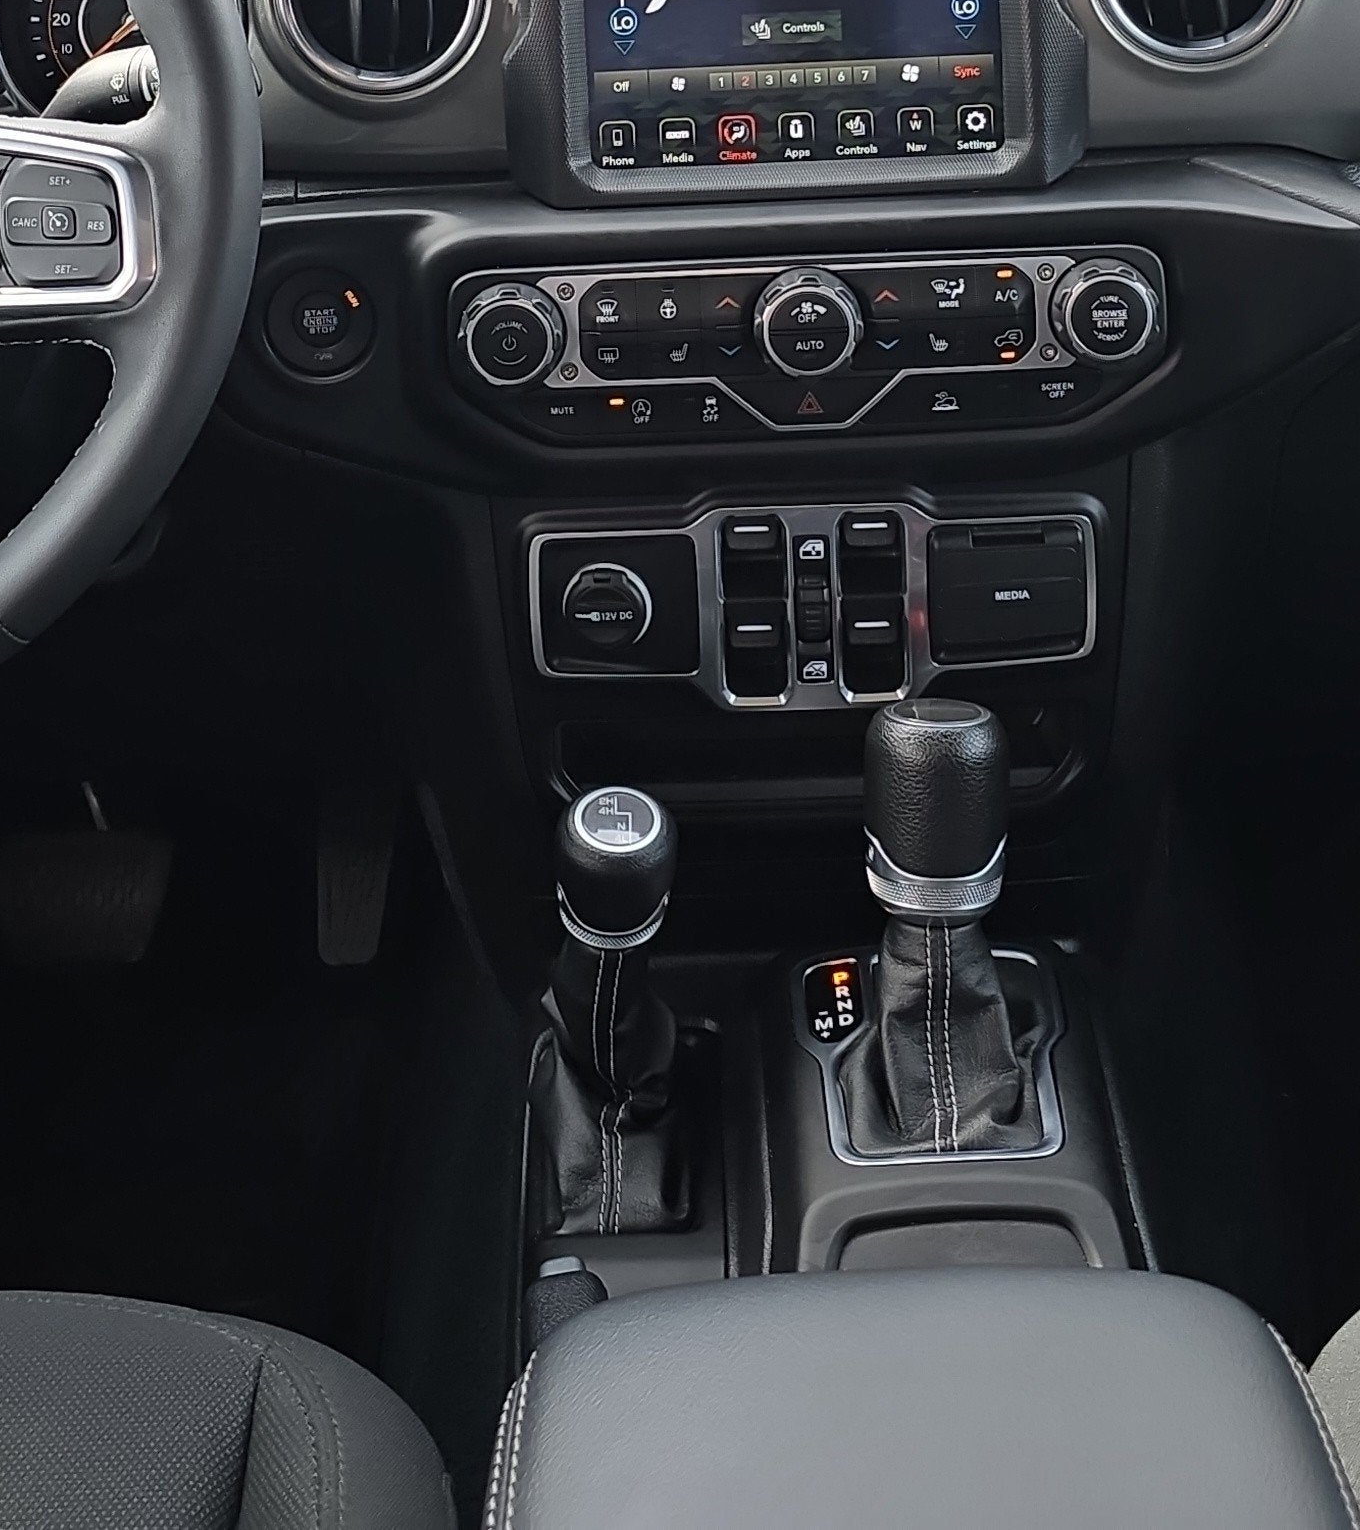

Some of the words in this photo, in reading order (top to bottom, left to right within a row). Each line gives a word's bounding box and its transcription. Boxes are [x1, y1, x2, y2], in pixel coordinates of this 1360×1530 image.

[954, 0, 976, 14] LO
[52, 13, 71, 26] 20
[613, 15, 635, 30] LO
[783, 21, 825, 35] Controls
[61, 43, 73, 54] 10
[954, 65, 980, 79] Sync
[718, 76, 724, 87] 1
[741, 76, 750, 87] 2
[765, 75, 774, 85] 3
[789, 73, 798, 84] 4
[814, 72, 821, 83] 5
[837, 71, 845, 82] 6
[861, 70, 869, 81] 7
[613, 81, 630, 92] Off
[112, 94, 130, 105] PULL
[909, 120, 922, 131] W
[836, 144, 878, 155] Controls
[906, 142, 927, 152] Nav
[957, 139, 997, 151] Settings
[662, 153, 694, 163] Media
[719, 150, 757, 161] Climate
[784, 148, 810, 159] Apps
[602, 155, 635, 167] Phone
[12, 217, 38, 227] CANC
[87, 221, 105, 231] RES
[994, 289, 1019, 302] A/C
[939, 300, 960, 308] MODE
[304, 309, 335, 317] START
[596, 314, 619, 323] FRONT
[797, 313, 818, 323] OFF
[1092, 309, 1128, 318] BROWSE
[303, 317, 338, 327] ENGINE
[494, 320, 524, 331] VOLUME
[1096, 320, 1125, 328] ENTER
[796, 339, 824, 351] AUTO
[1041, 381, 1074, 391] SCREEN
[1049, 390, 1066, 399] OFF
[550, 406, 575, 415] MUTE
[633, 416, 651, 424] OFF
[702, 413, 720, 423] OFF
[994, 589, 1031, 602] MEDIA
[601, 610, 617, 621] 12V
[618, 610, 633, 621] DC
[598, 807, 614, 816] 4H
[617, 822, 625, 830] N
[833, 972, 849, 985] P
[835, 985, 851, 998] R
[837, 998, 853, 1012] N
[815, 1017, 833, 1031] M
[838, 1014, 854, 1026] D
